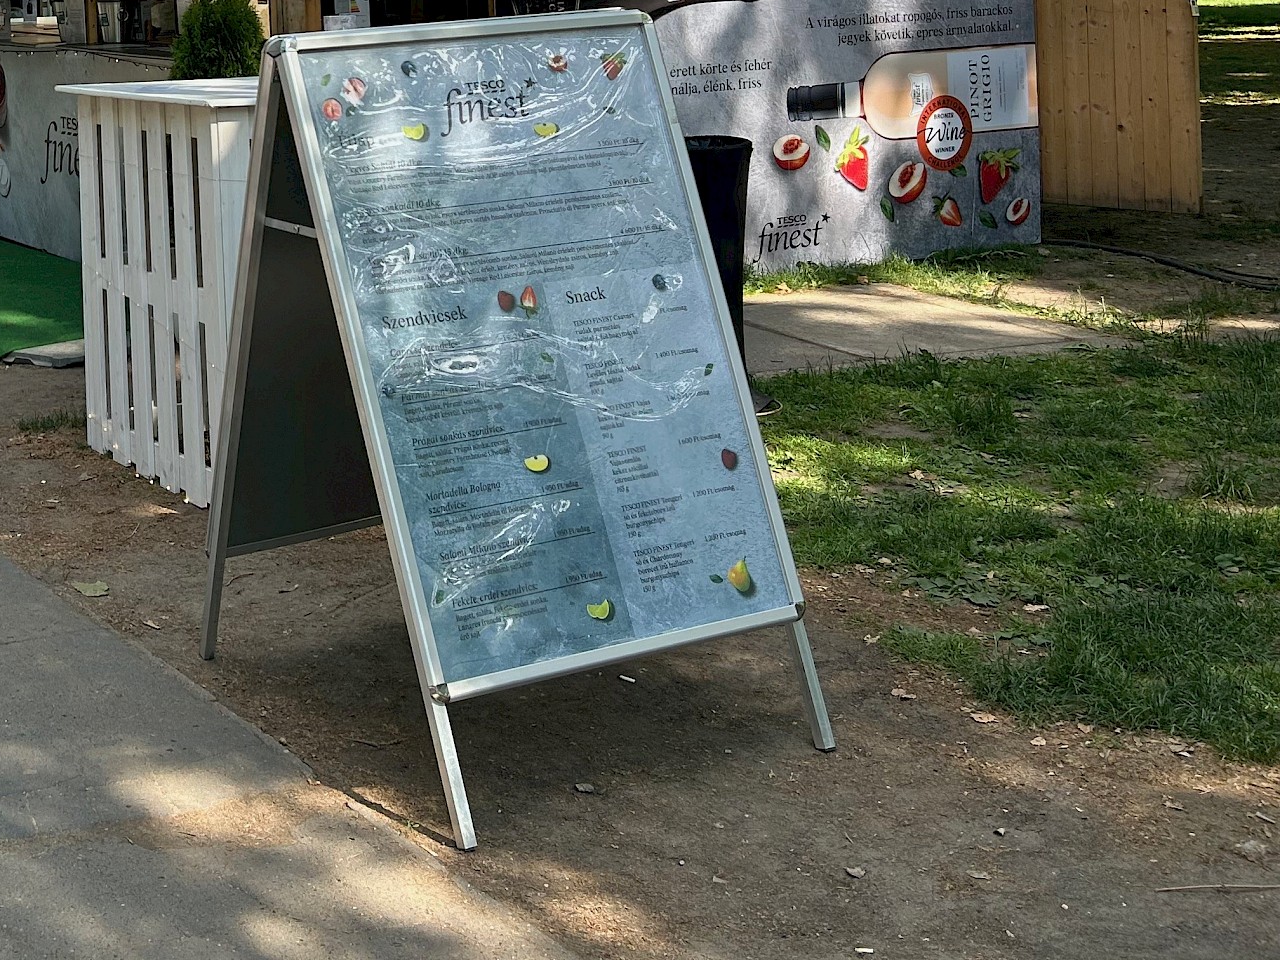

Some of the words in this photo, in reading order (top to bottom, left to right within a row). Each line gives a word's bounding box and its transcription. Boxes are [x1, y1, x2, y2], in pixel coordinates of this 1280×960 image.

[805, 17, 815, 29] A
[817, 14, 857, 32] virágos
[859, 10, 901, 25] illatokat
[903, 8, 945, 25] ropogós,
[947, 6, 969, 19] friss
[970, 4, 1013, 17] barackos
[837, 29, 872, 47] jegyek
[916, 26, 944, 41] epres
[669, 65, 697, 78] érett
[699, 62, 729, 76] körte
[730, 59, 742, 73] és
[744, 57, 773, 72] fehér
[465, 79, 504, 91] TESCO
[671, 82, 701, 97] nálja,
[738, 76, 762, 90] friss
[968, 59, 980, 119] PINOT
[980, 54, 992, 122] GRIGIO
[441, 88, 531, 137] finest
[60, 116, 78, 131] TES
[917, 122, 972, 144] Wine
[40, 120, 79, 184] fine
[934, 146, 956, 154] WINNER
[776, 214, 807, 224] TESCO
[753, 220, 823, 263] finest
[565, 286, 606, 304] Snack
[382, 305, 467, 328] Szendvicsek
[412, 435, 438, 446] Prágai
